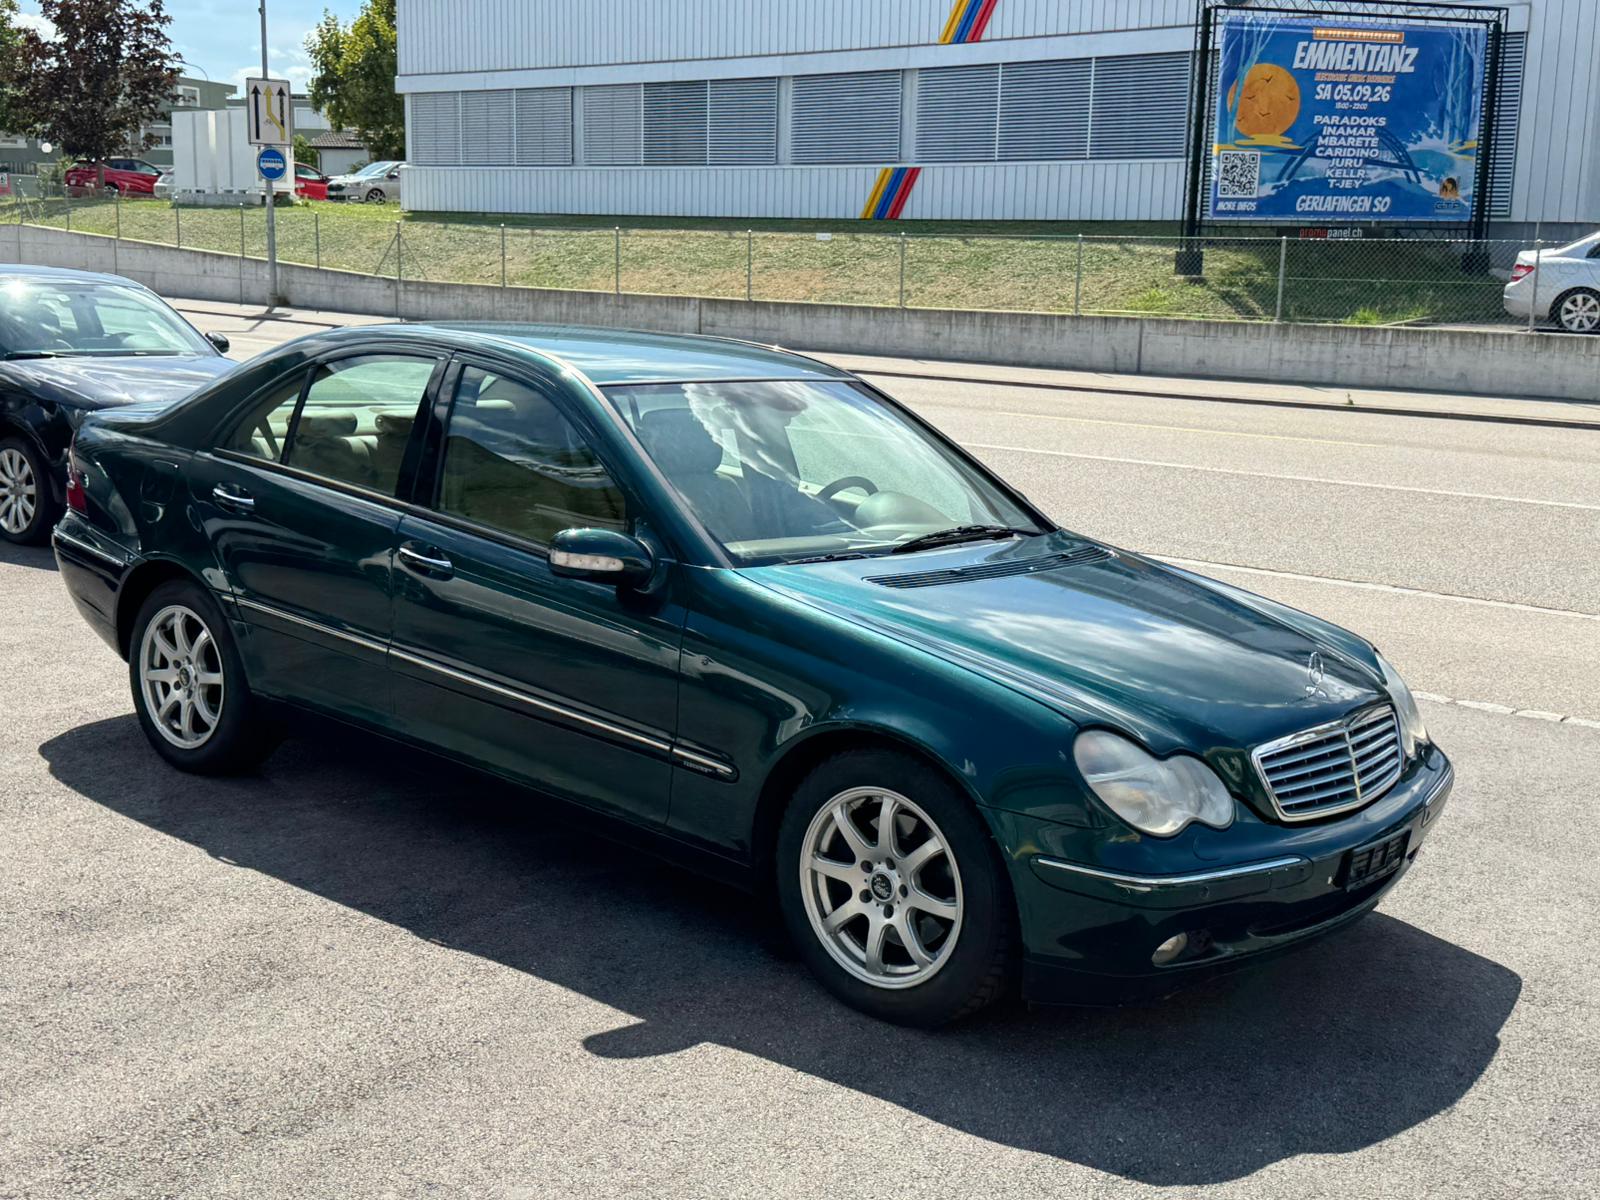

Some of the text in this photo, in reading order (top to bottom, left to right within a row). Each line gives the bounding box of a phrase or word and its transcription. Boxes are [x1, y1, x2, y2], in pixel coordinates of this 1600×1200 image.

[1293, 41, 1419, 72] EMMENTANZ
[1315, 84, 1391, 102] SA 05.09.26
[1313, 115, 1387, 126] PARADOKS
[1323, 126, 1376, 136] INAMAR
[1317, 136, 1379, 147] MBARETE
[1315, 147, 1379, 157] CARIDINO
[1329, 158, 1363, 167] JURU
[1326, 169, 1366, 178] KELLR
[1328, 179, 1363, 188] T-JEY
[1296, 195, 1391, 212] GERLAFINGEN SO
